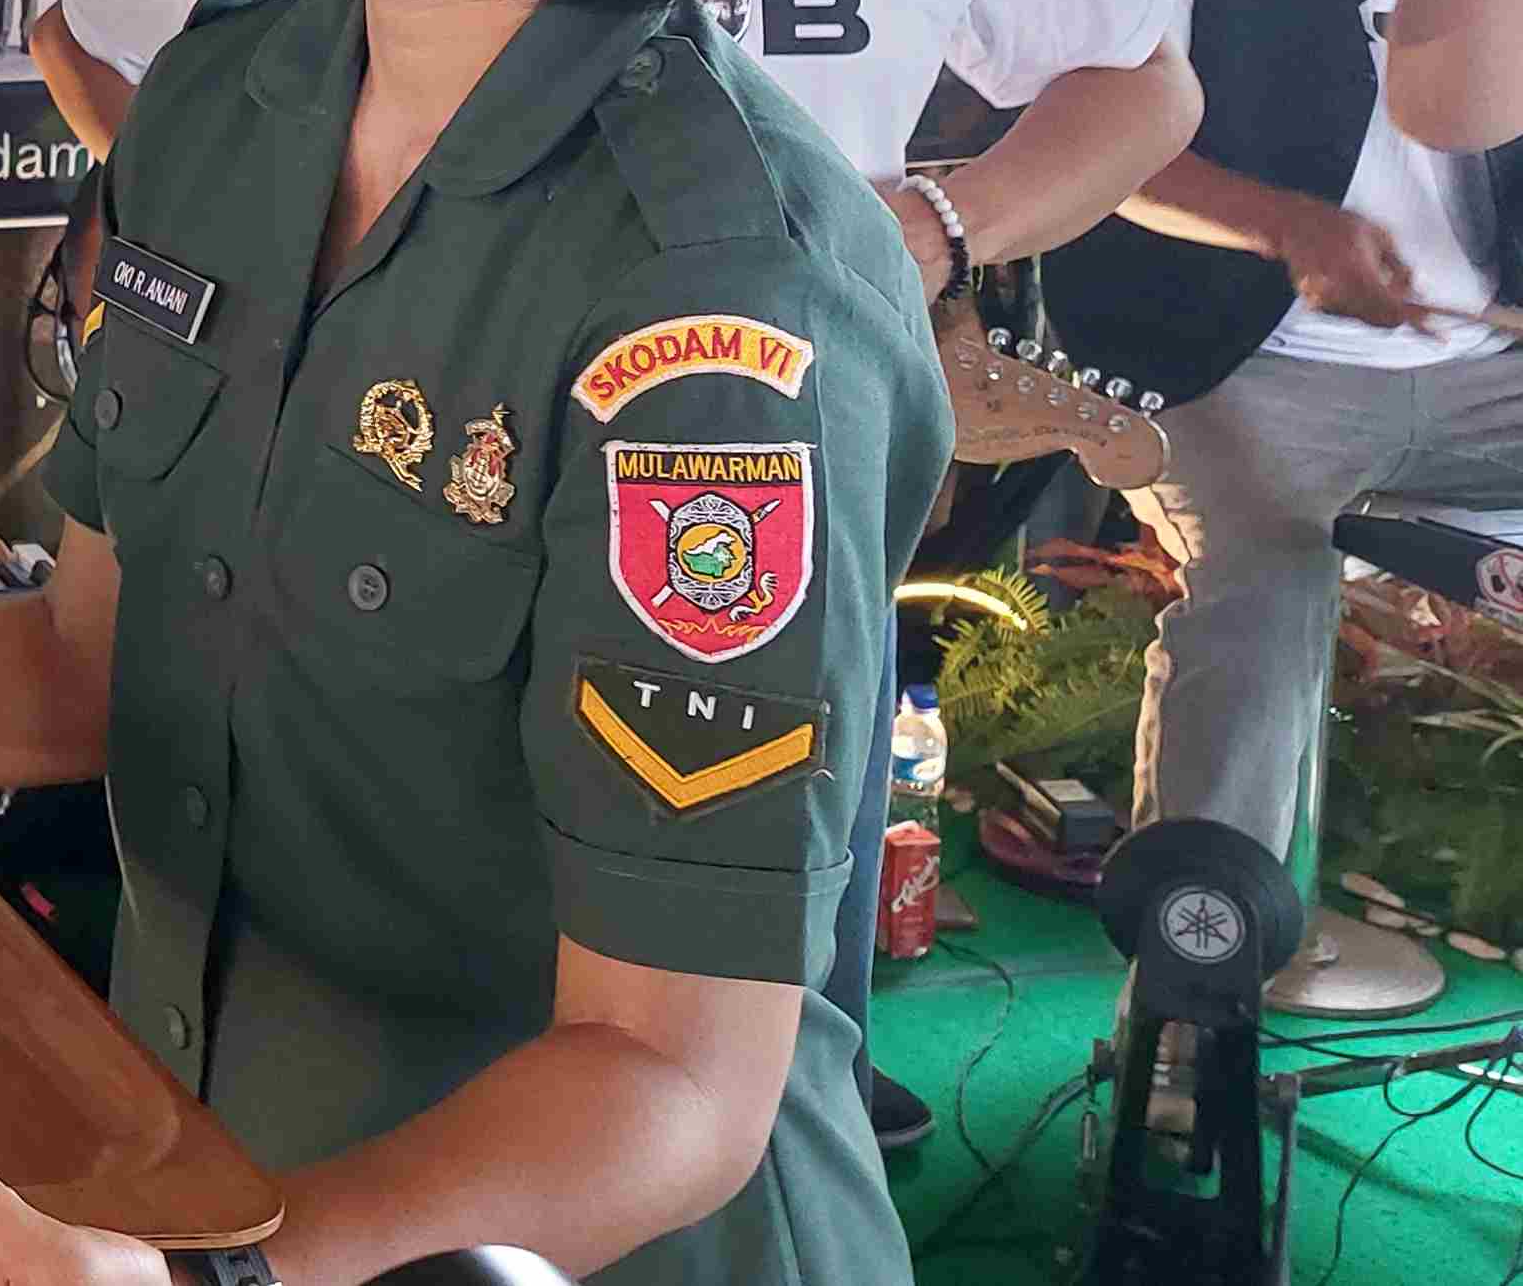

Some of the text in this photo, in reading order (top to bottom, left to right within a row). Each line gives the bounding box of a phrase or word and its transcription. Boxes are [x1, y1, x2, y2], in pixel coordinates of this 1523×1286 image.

[588, 326, 793, 400] SKODAM VI
[617, 451, 802, 482] MULAWARMAN
[632, 679, 755, 731] TNI
